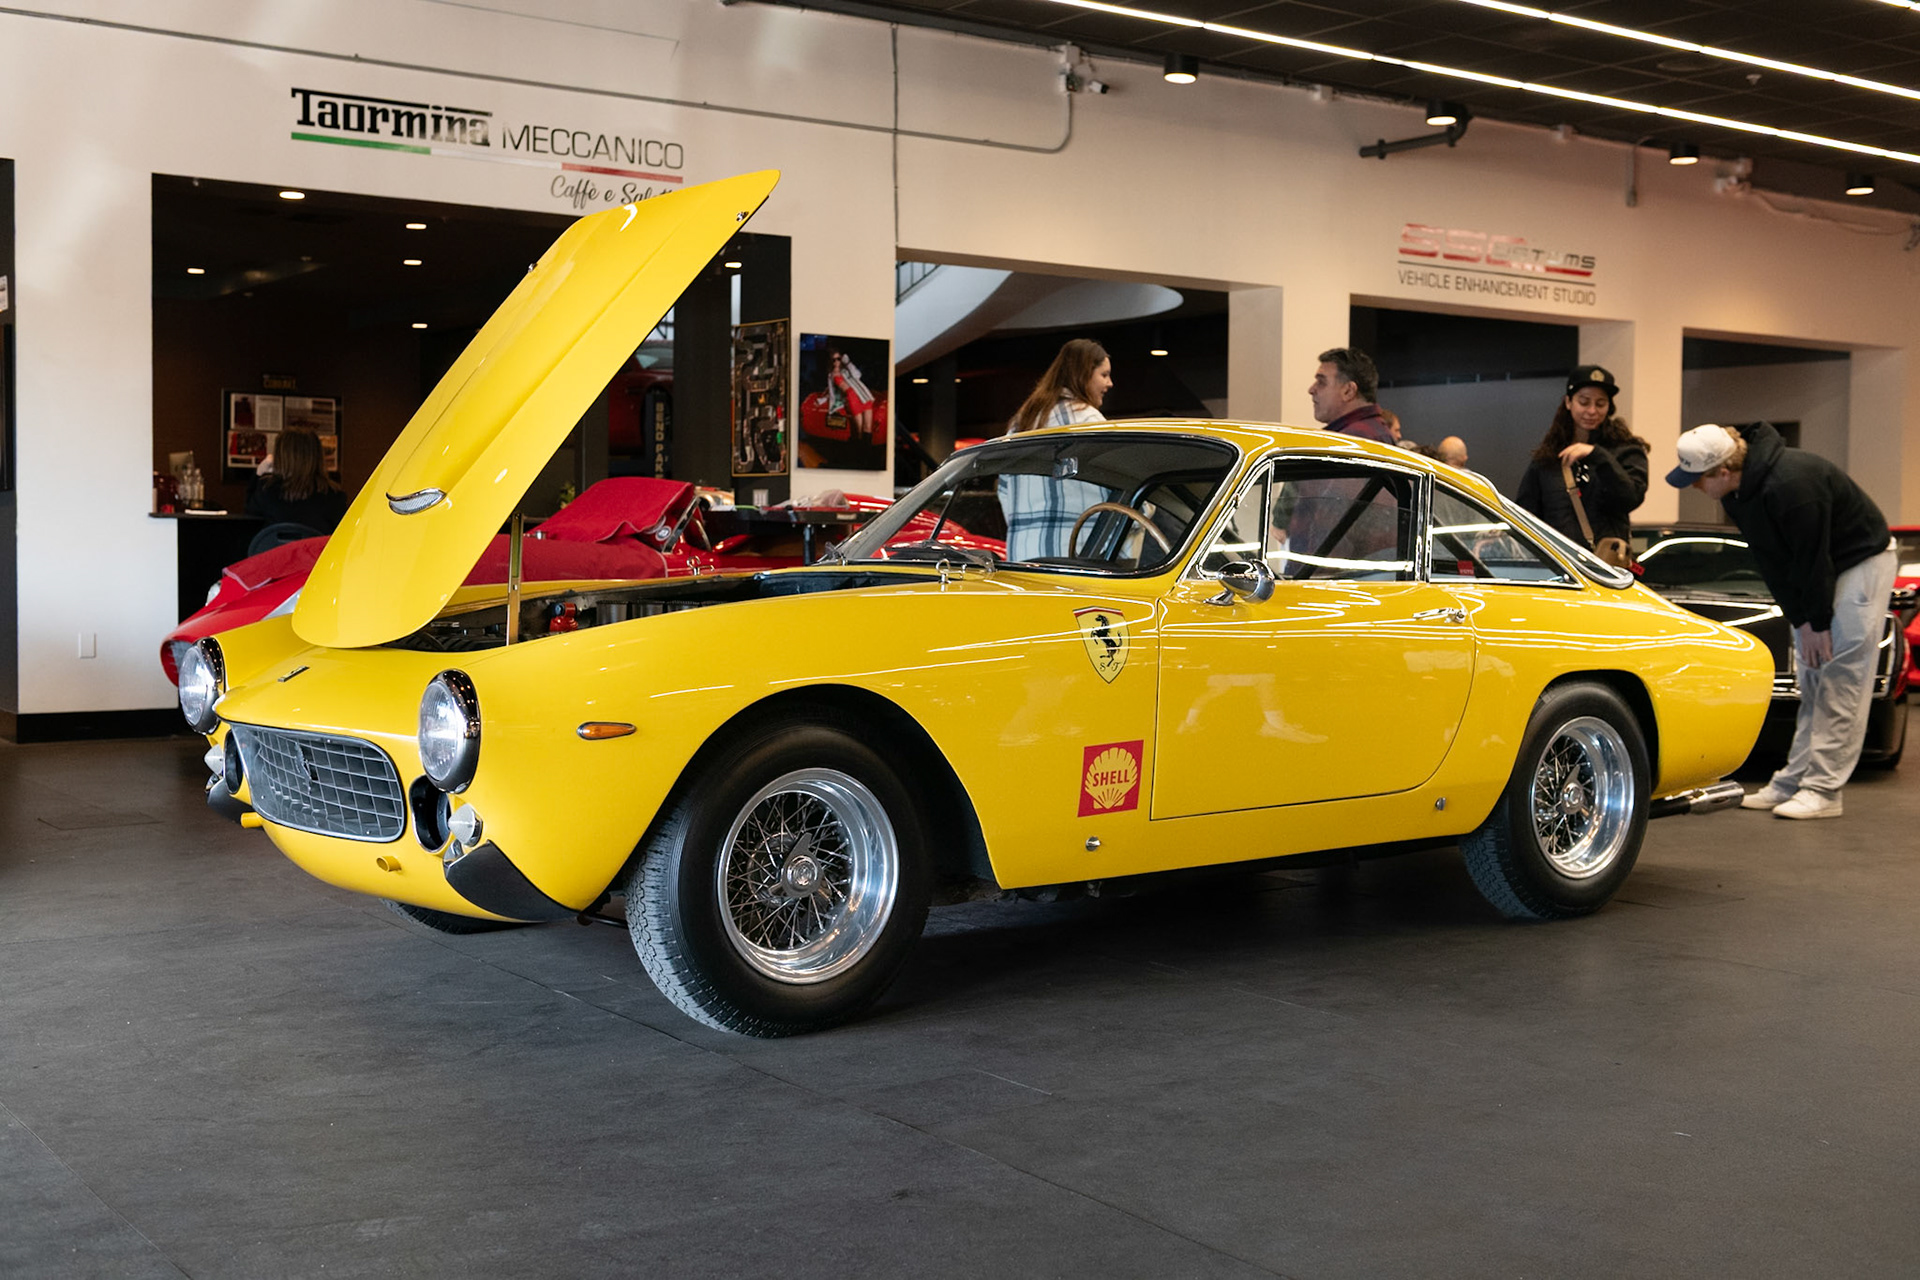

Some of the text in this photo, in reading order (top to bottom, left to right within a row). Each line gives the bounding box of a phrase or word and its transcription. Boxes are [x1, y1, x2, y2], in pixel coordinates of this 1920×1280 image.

[291, 87, 684, 170] Taormina MECCANICO
[550, 174, 599, 210] Caffè
[604, 189, 615, 201] e
[1398, 270, 1596, 306] VEHICLE ENHANCEMENT STUDIO
[1092, 769, 1130, 787] SHELL
